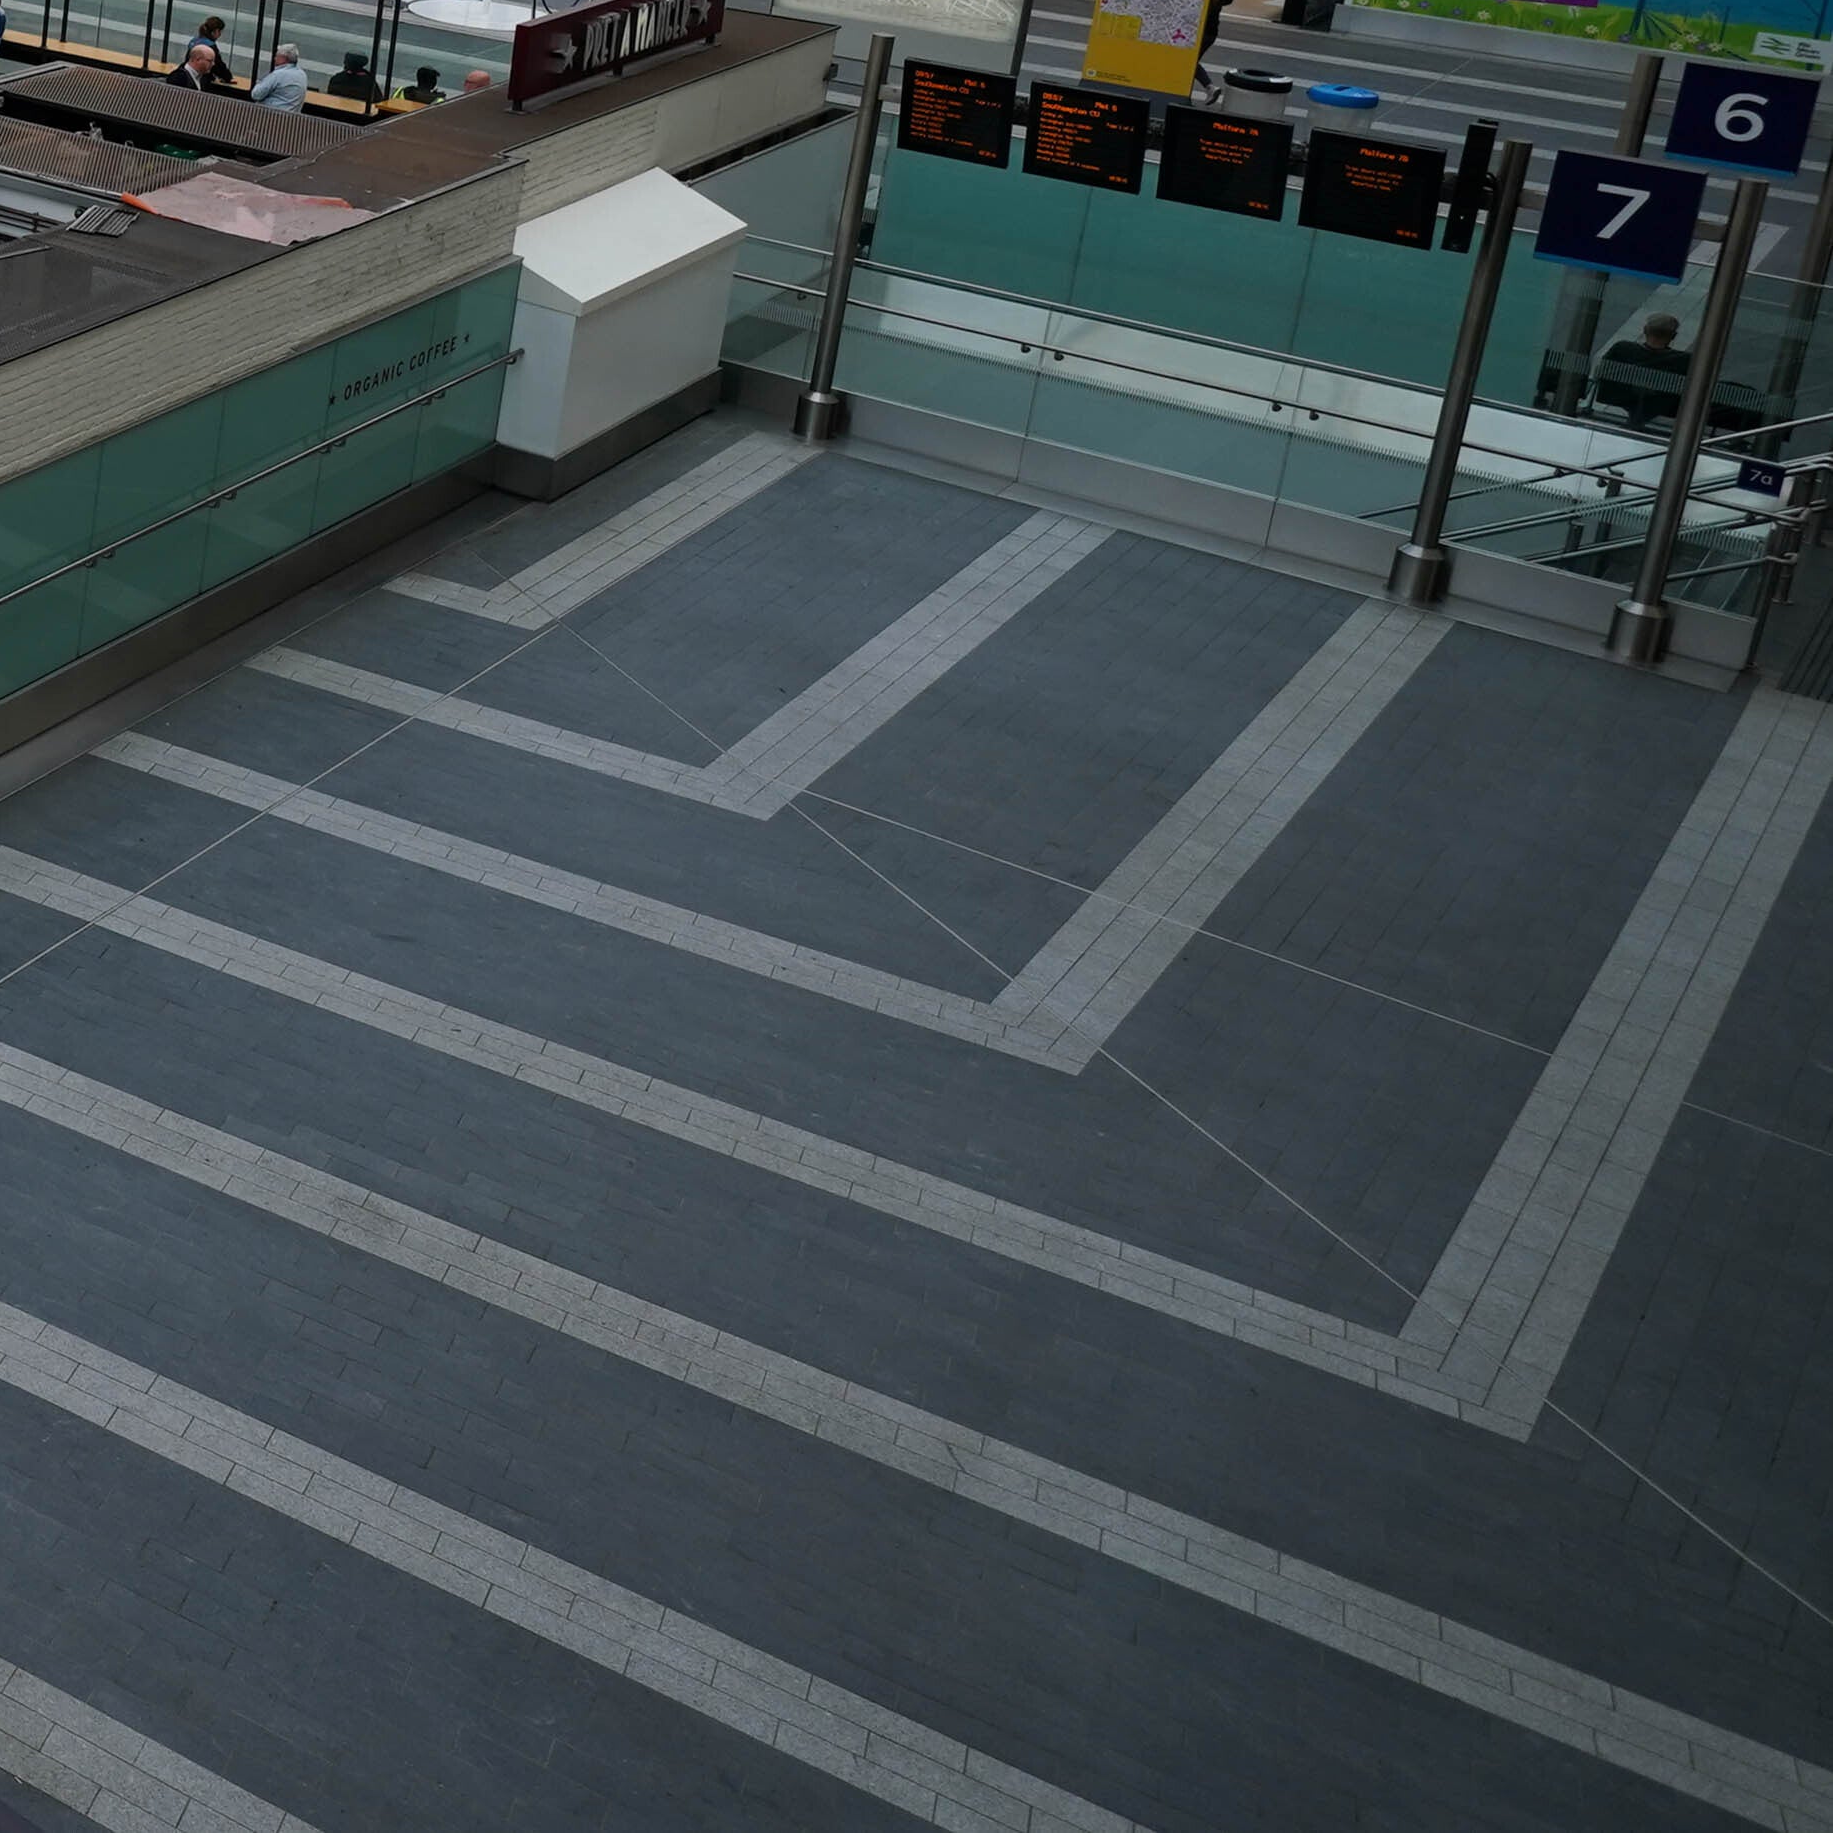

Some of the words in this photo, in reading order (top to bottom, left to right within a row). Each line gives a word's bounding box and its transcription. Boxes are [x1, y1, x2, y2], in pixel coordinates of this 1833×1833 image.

[583, 11, 622, 71] PRET
[618, 10, 632, 59] A
[1041, 101, 1087, 116] Southampton
[1094, 101, 1109, 111] Plat
[1713, 92, 1769, 143] 6
[1212, 121, 1246, 134] Platform
[1359, 147, 1396, 162] Platform
[1593, 182, 1651, 240] 7
[343, 360, 405, 401] ORGANIC
[408, 335, 458, 371] COFFEE
[1749, 469, 1773, 486] 7a
